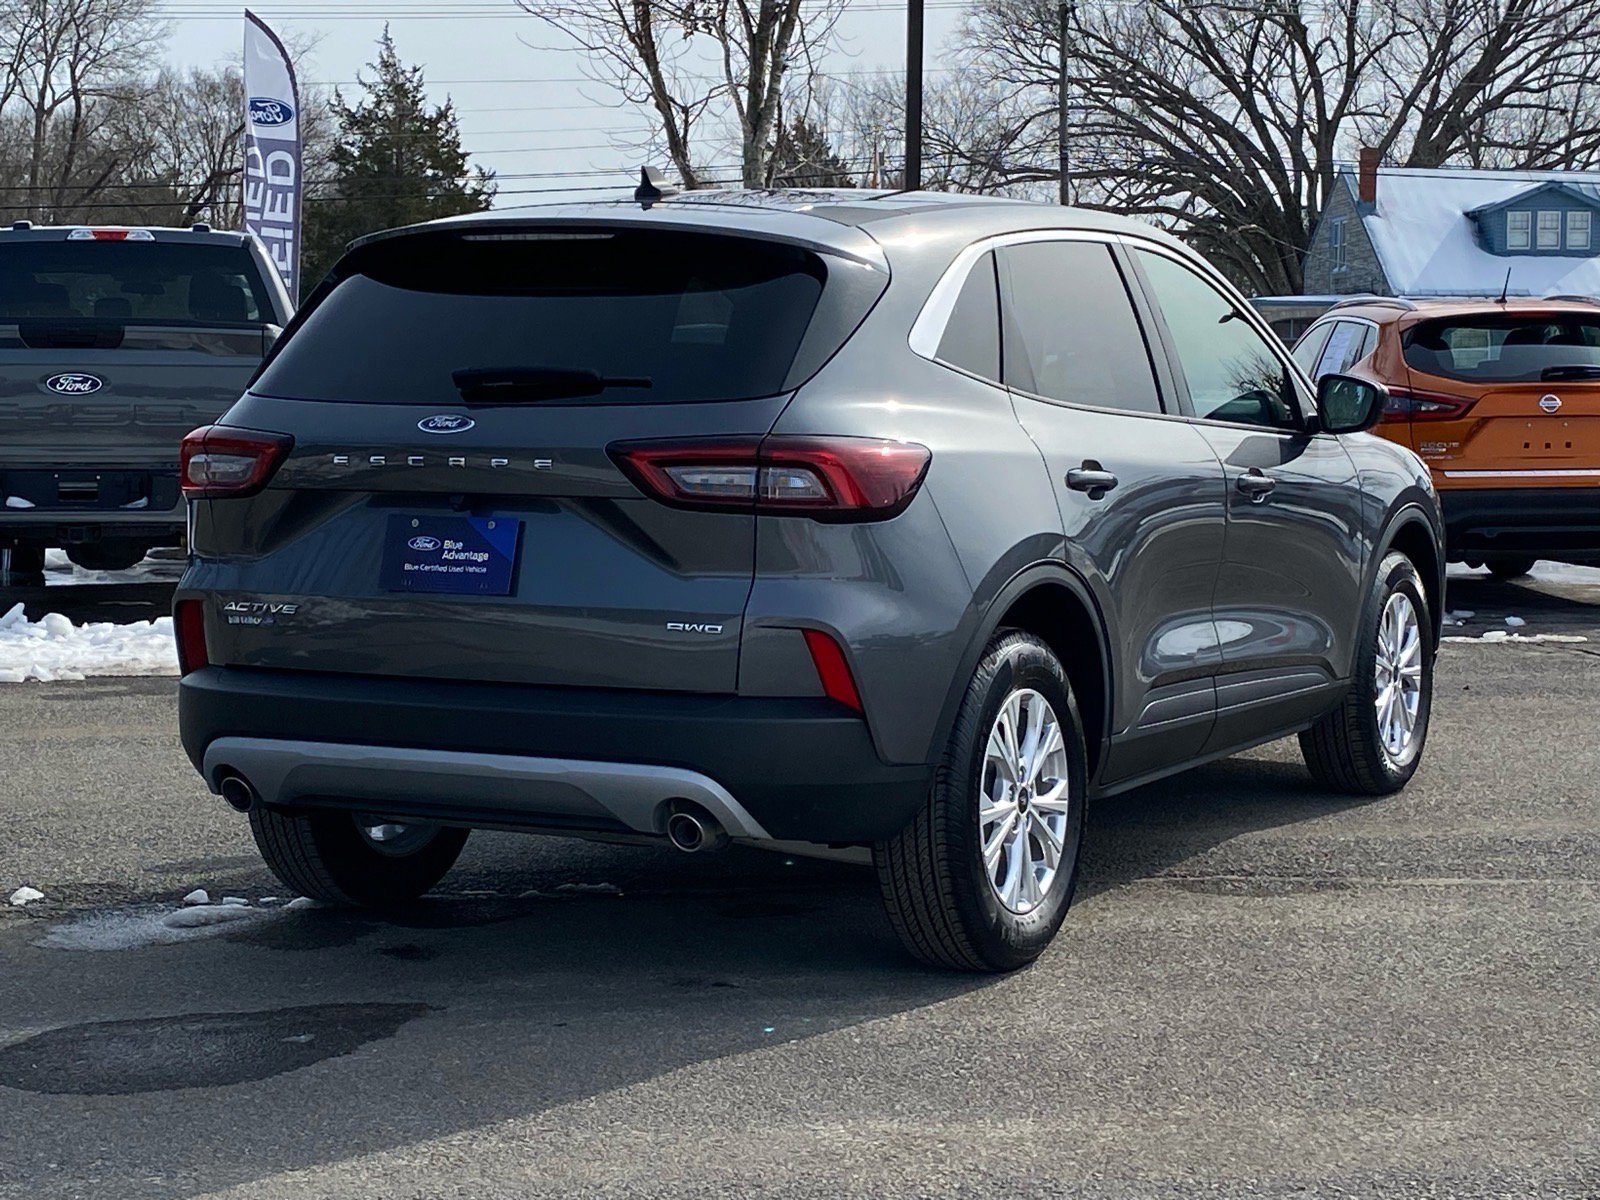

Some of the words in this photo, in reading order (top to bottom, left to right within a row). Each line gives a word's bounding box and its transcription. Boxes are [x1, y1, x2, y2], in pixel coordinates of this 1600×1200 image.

[333, 455, 553, 470] ESCAPE
[443, 540, 463, 549] Blue
[441, 550, 489, 562] Advantage
[404, 563, 419, 571] Blue
[420, 563, 448, 572] Certified
[448, 564, 464, 573] Used
[465, 565, 487, 574] Vehicle
[224, 602, 298, 614] ACTIVE
